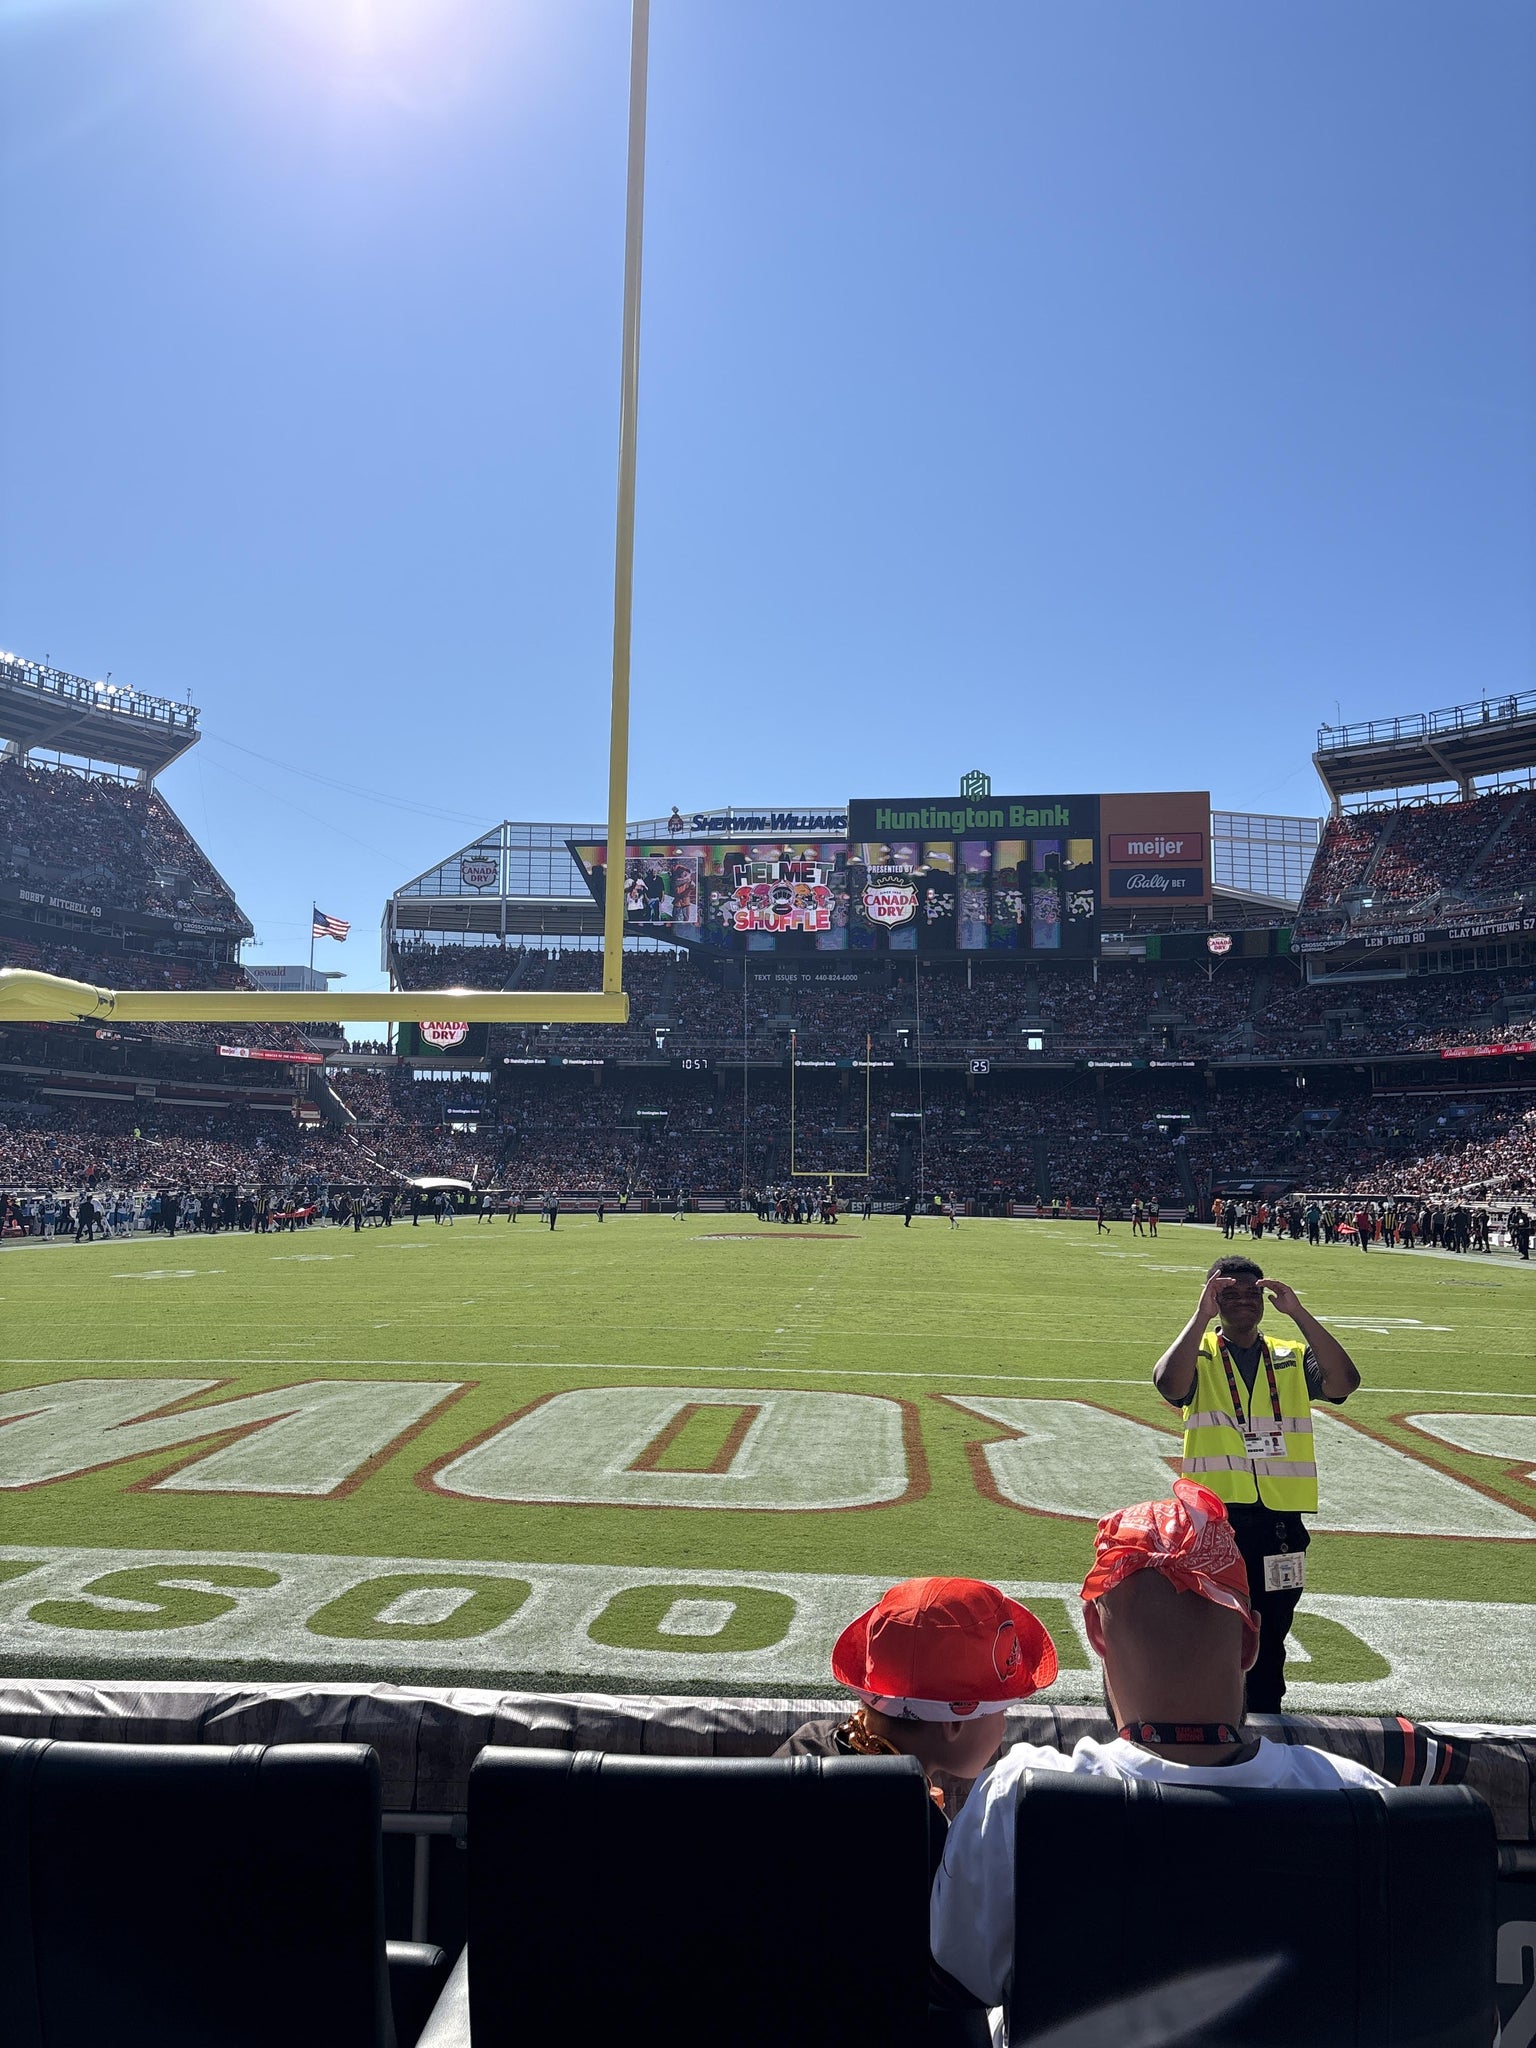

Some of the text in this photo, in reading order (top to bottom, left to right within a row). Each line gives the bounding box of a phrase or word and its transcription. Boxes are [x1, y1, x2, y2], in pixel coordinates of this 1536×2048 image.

[876, 804, 1070, 834] Huntington Bank
[1127, 837, 1183, 858] meijer
[462, 866, 498, 875] CANADA
[733, 861, 834, 887] HELMET
[867, 865, 914, 873] PRESENTED BY
[1126, 873, 1186, 891] Bally BET
[19, 889, 102, 917] BOBBY MITCHELL 49
[864, 894, 918, 906] CANADA
[877, 906, 905, 917] DRY
[734, 909, 831, 932] SHUFFLE
[183, 922, 226, 933] CROSSCOUNTRY
[1449, 918, 1536, 939] CLAY MATTHEWS 57
[1365, 932, 1426, 947] LEN FORD 80
[254, 966, 286, 977] oswald
[421, 1022, 469, 1031] CANADA
[432, 1031, 456, 1040] DRY
[973, 1061, 987, 1072] 25
